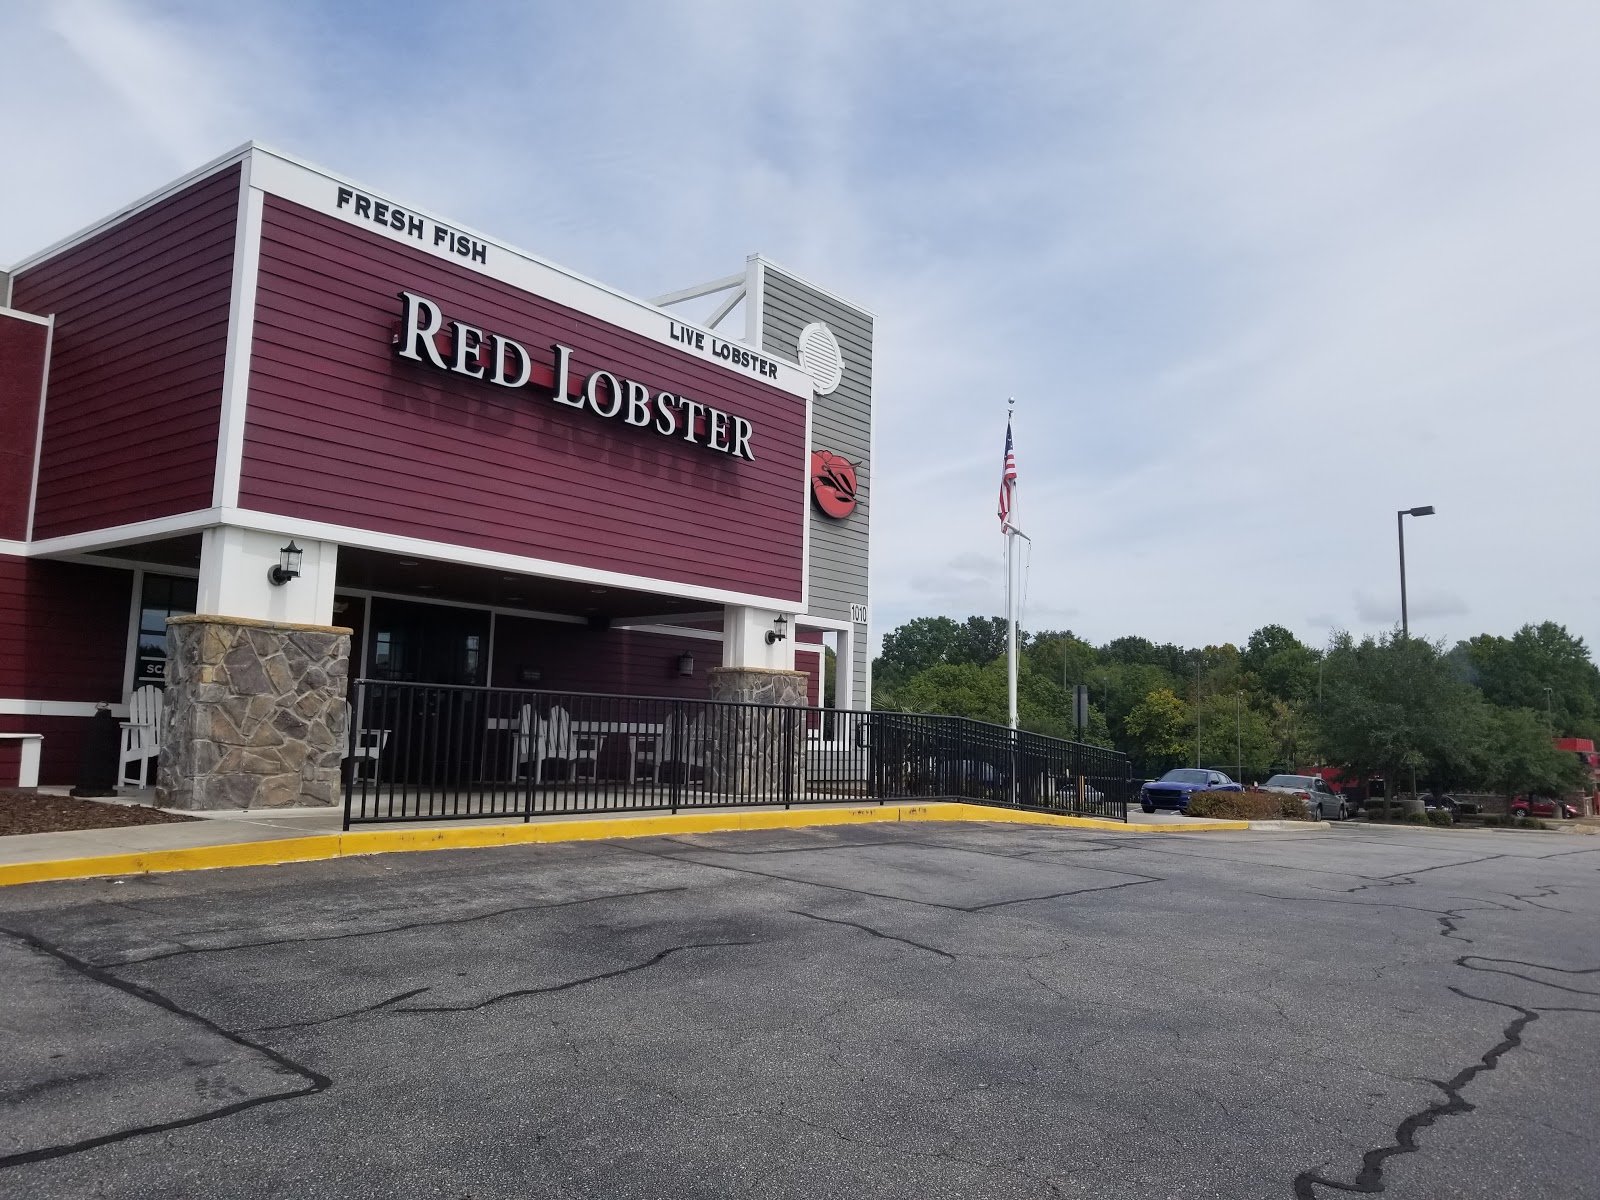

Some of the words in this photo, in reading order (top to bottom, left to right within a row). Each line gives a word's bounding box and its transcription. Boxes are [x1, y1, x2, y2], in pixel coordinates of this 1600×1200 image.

[336, 186, 424, 240] FRESH
[433, 225, 487, 265] FISH
[398, 291, 532, 388] RED
[551, 343, 755, 462] LOBSTER
[670, 321, 705, 351] LIVE
[712, 338, 778, 380] LOBSTER
[851, 604, 867, 623] 1010
[146, 664, 164, 674] SC
